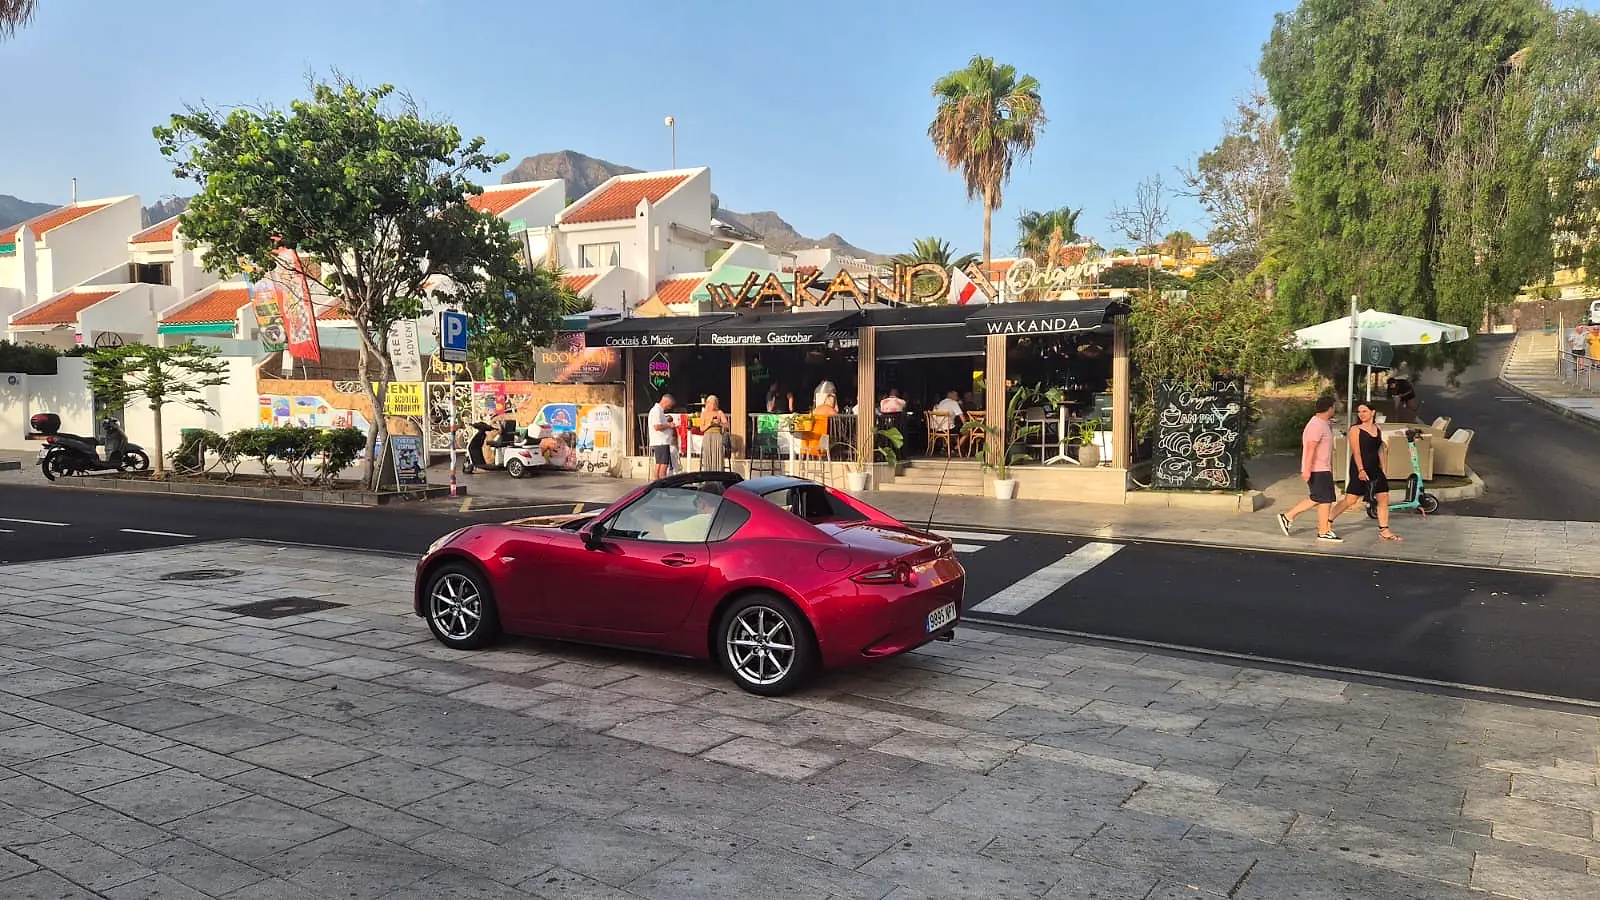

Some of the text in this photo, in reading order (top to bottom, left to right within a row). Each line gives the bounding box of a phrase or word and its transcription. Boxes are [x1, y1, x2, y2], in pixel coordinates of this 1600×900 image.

[705, 260, 1000, 308] WAKANDA
[1005, 257, 1105, 302] Origen
[447, 317, 462, 345] P
[987, 317, 1080, 334] WAKANDA
[605, 335, 674, 346] Cocktails & Music
[711, 332, 813, 344] Restaurante Gastrobar
